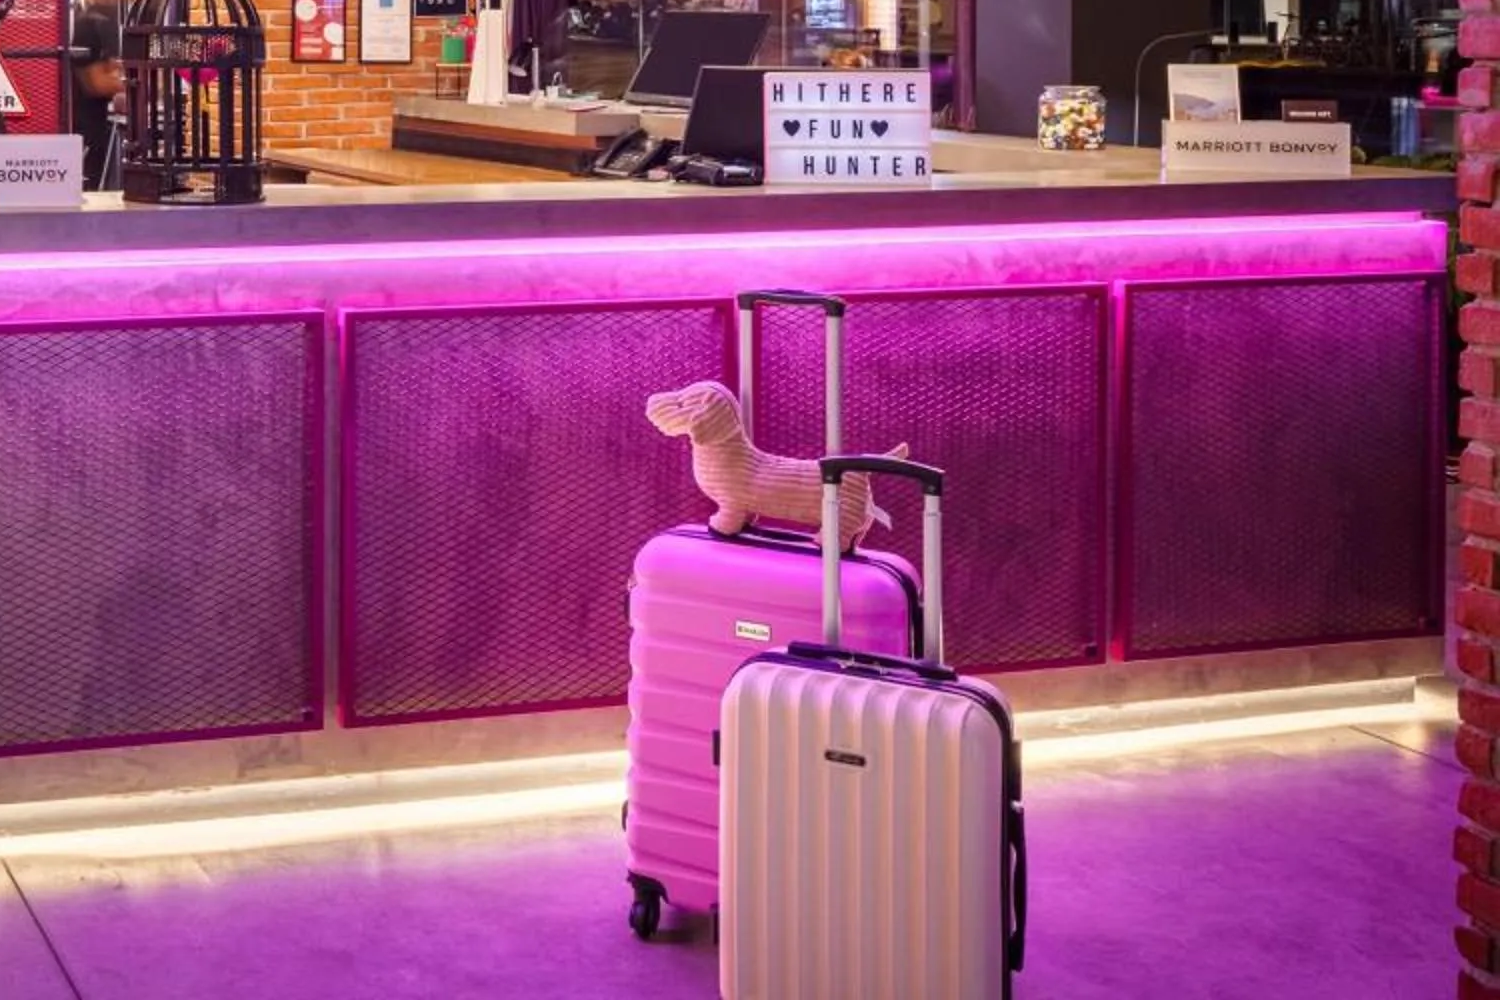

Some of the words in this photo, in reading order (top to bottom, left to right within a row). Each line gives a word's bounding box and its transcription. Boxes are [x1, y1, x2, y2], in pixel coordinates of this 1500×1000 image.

[808, 119, 864, 139] FUN
[1176, 140, 1263, 153] MARRIOTT
[1269, 142, 1338, 155] BONVOY
[5, 159, 60, 167] MARRIOTT
[803, 156, 927, 176] HUNTER
